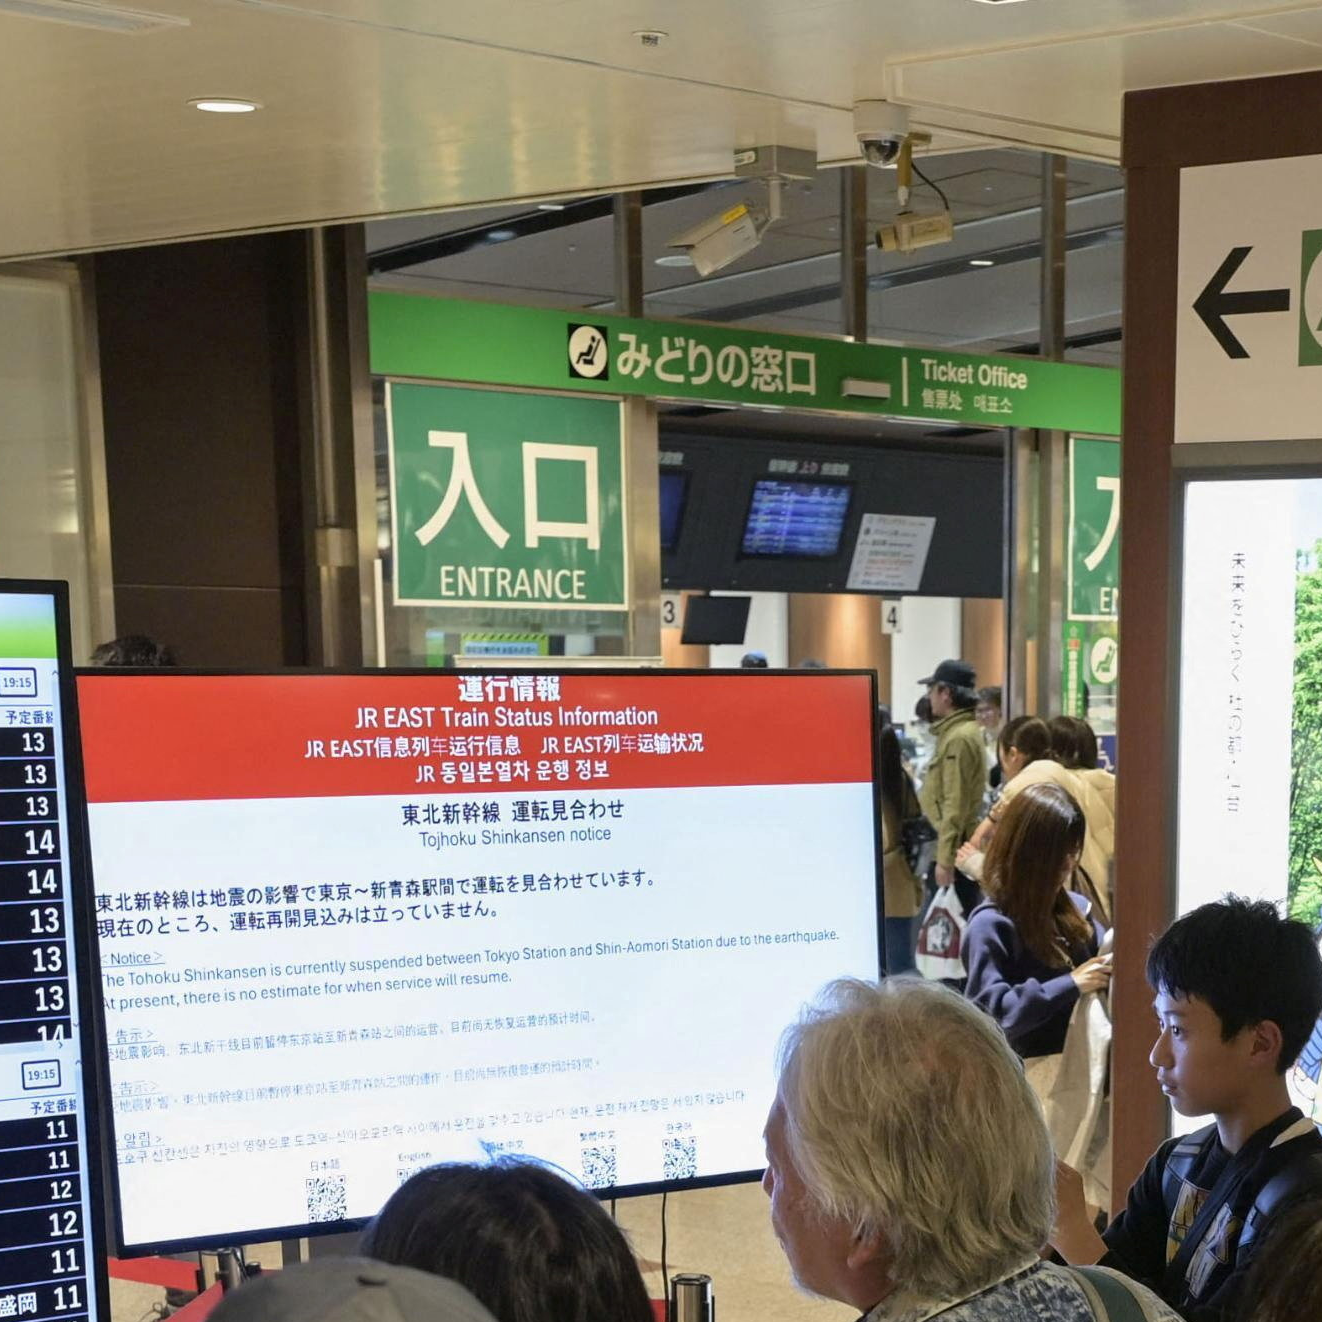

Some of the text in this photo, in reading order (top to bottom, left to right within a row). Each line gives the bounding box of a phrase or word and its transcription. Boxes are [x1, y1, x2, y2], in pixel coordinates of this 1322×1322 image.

[616, 333, 816, 396] みどりの窓口
[921, 357, 1028, 390] Ticket Office
[414, 429, 600, 551] 入口
[439, 565, 587, 601] ENTRANCE
[663, 601, 674, 623] 3
[887, 607, 897, 627] 4
[3, 677, 32, 688] 19:15
[458, 675, 561, 703] 運行情報
[355, 706, 658, 729] JR EAST Train Status Information
[22, 732, 45, 753] 13
[305, 740, 325, 758] JR
[541, 737, 560, 754] JR
[415, 760, 610, 783] JR 동일본열차 운행 정보
[401, 798, 625, 826] 東北新幹線 運転見合わせ
[419, 827, 611, 851] Tojhoku Shinkansen notice
[30, 907, 60, 933] 13
[101, 928, 839, 987] he Tohoku Shinkansen is currently suspended between Tokyo Station and Shin-Aomori Station due to the earthquake.
[119, 970, 511, 1011] present, there is no estimate for when service will resume.
[28, 1068, 55, 1081] 19:15
